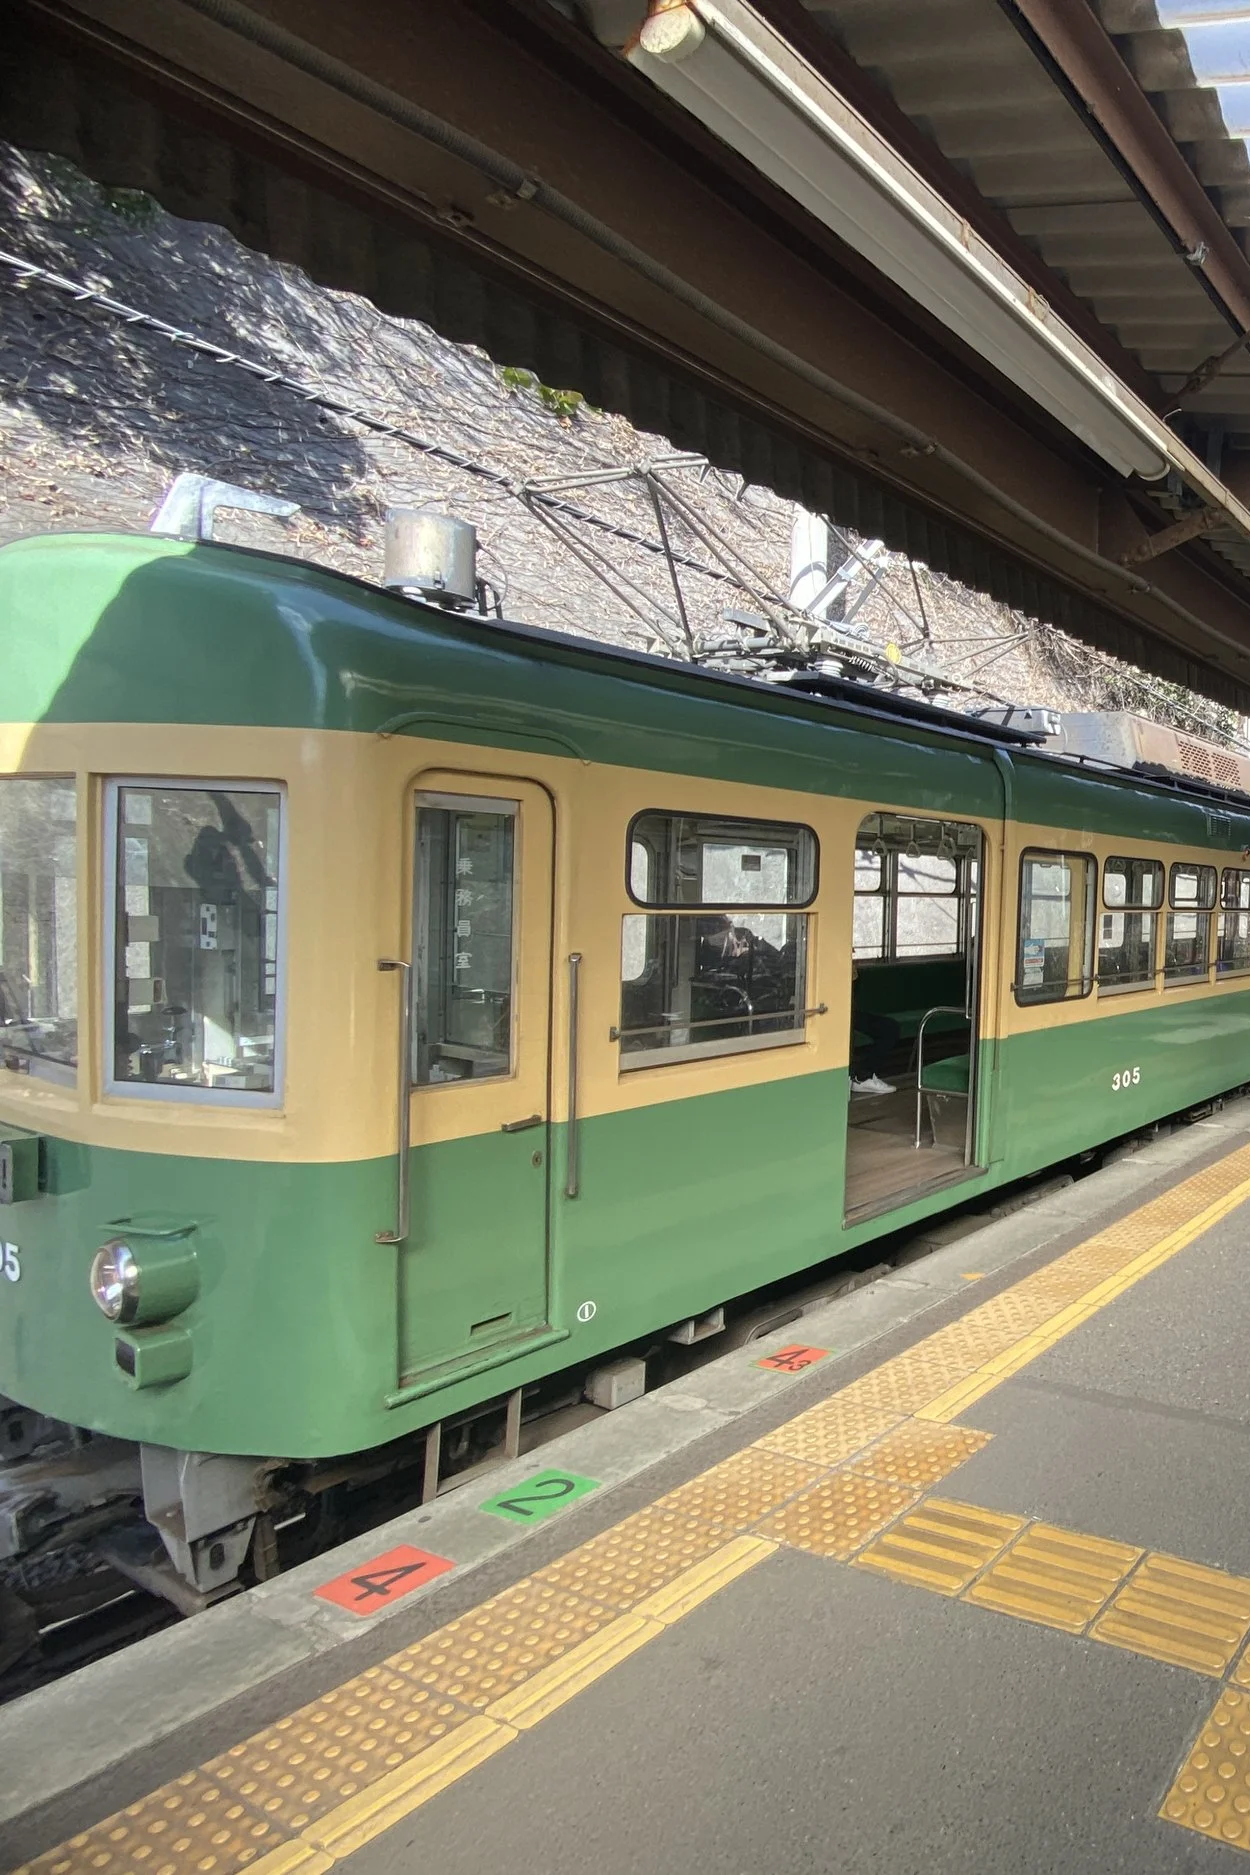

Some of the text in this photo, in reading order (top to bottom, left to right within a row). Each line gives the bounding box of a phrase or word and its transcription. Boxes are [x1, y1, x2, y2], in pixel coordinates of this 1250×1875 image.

[455, 857, 473, 969] 乗務員室
[1111, 1066, 1141, 1091] 305
[497, 1478, 576, 1516] 2
[351, 1561, 426, 1601] 4
